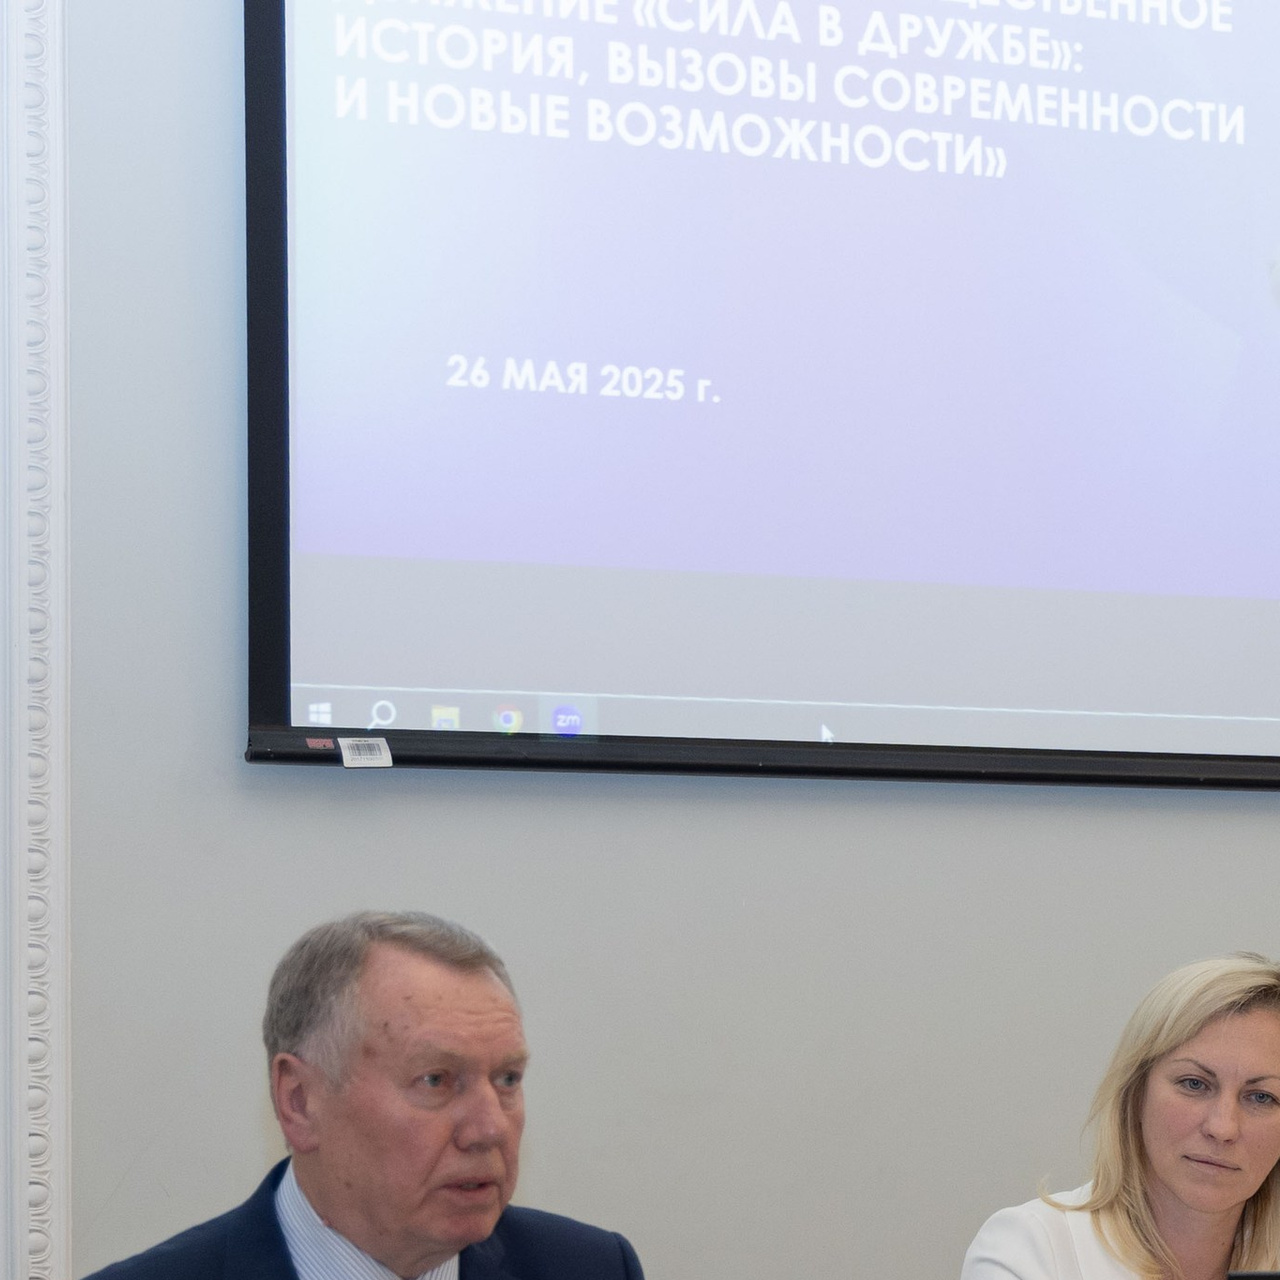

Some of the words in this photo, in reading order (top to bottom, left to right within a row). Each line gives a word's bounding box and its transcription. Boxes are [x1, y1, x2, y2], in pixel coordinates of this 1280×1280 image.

[335, 13, 589, 86] ИСТОРИЯ,
[607, 40, 817, 104] ВЫЗОВЫ
[833, 64, 1246, 145] СОВРЕМЕННОСТИ
[633, 0, 801, 43] «СИЛА
[818, 4, 844, 47] В
[857, 10, 1084, 74] ДРУЖБЕ»:
[335, 75, 367, 121] И
[387, 80, 571, 138] НОВЫЕ
[586, 97, 1007, 178] ВОЗМОЖНОСТИ»
[445, 354, 491, 389] 26
[502, 357, 588, 395] МАЯ
[600, 364, 685, 401] 2025
[697, 378, 721, 404] г.
